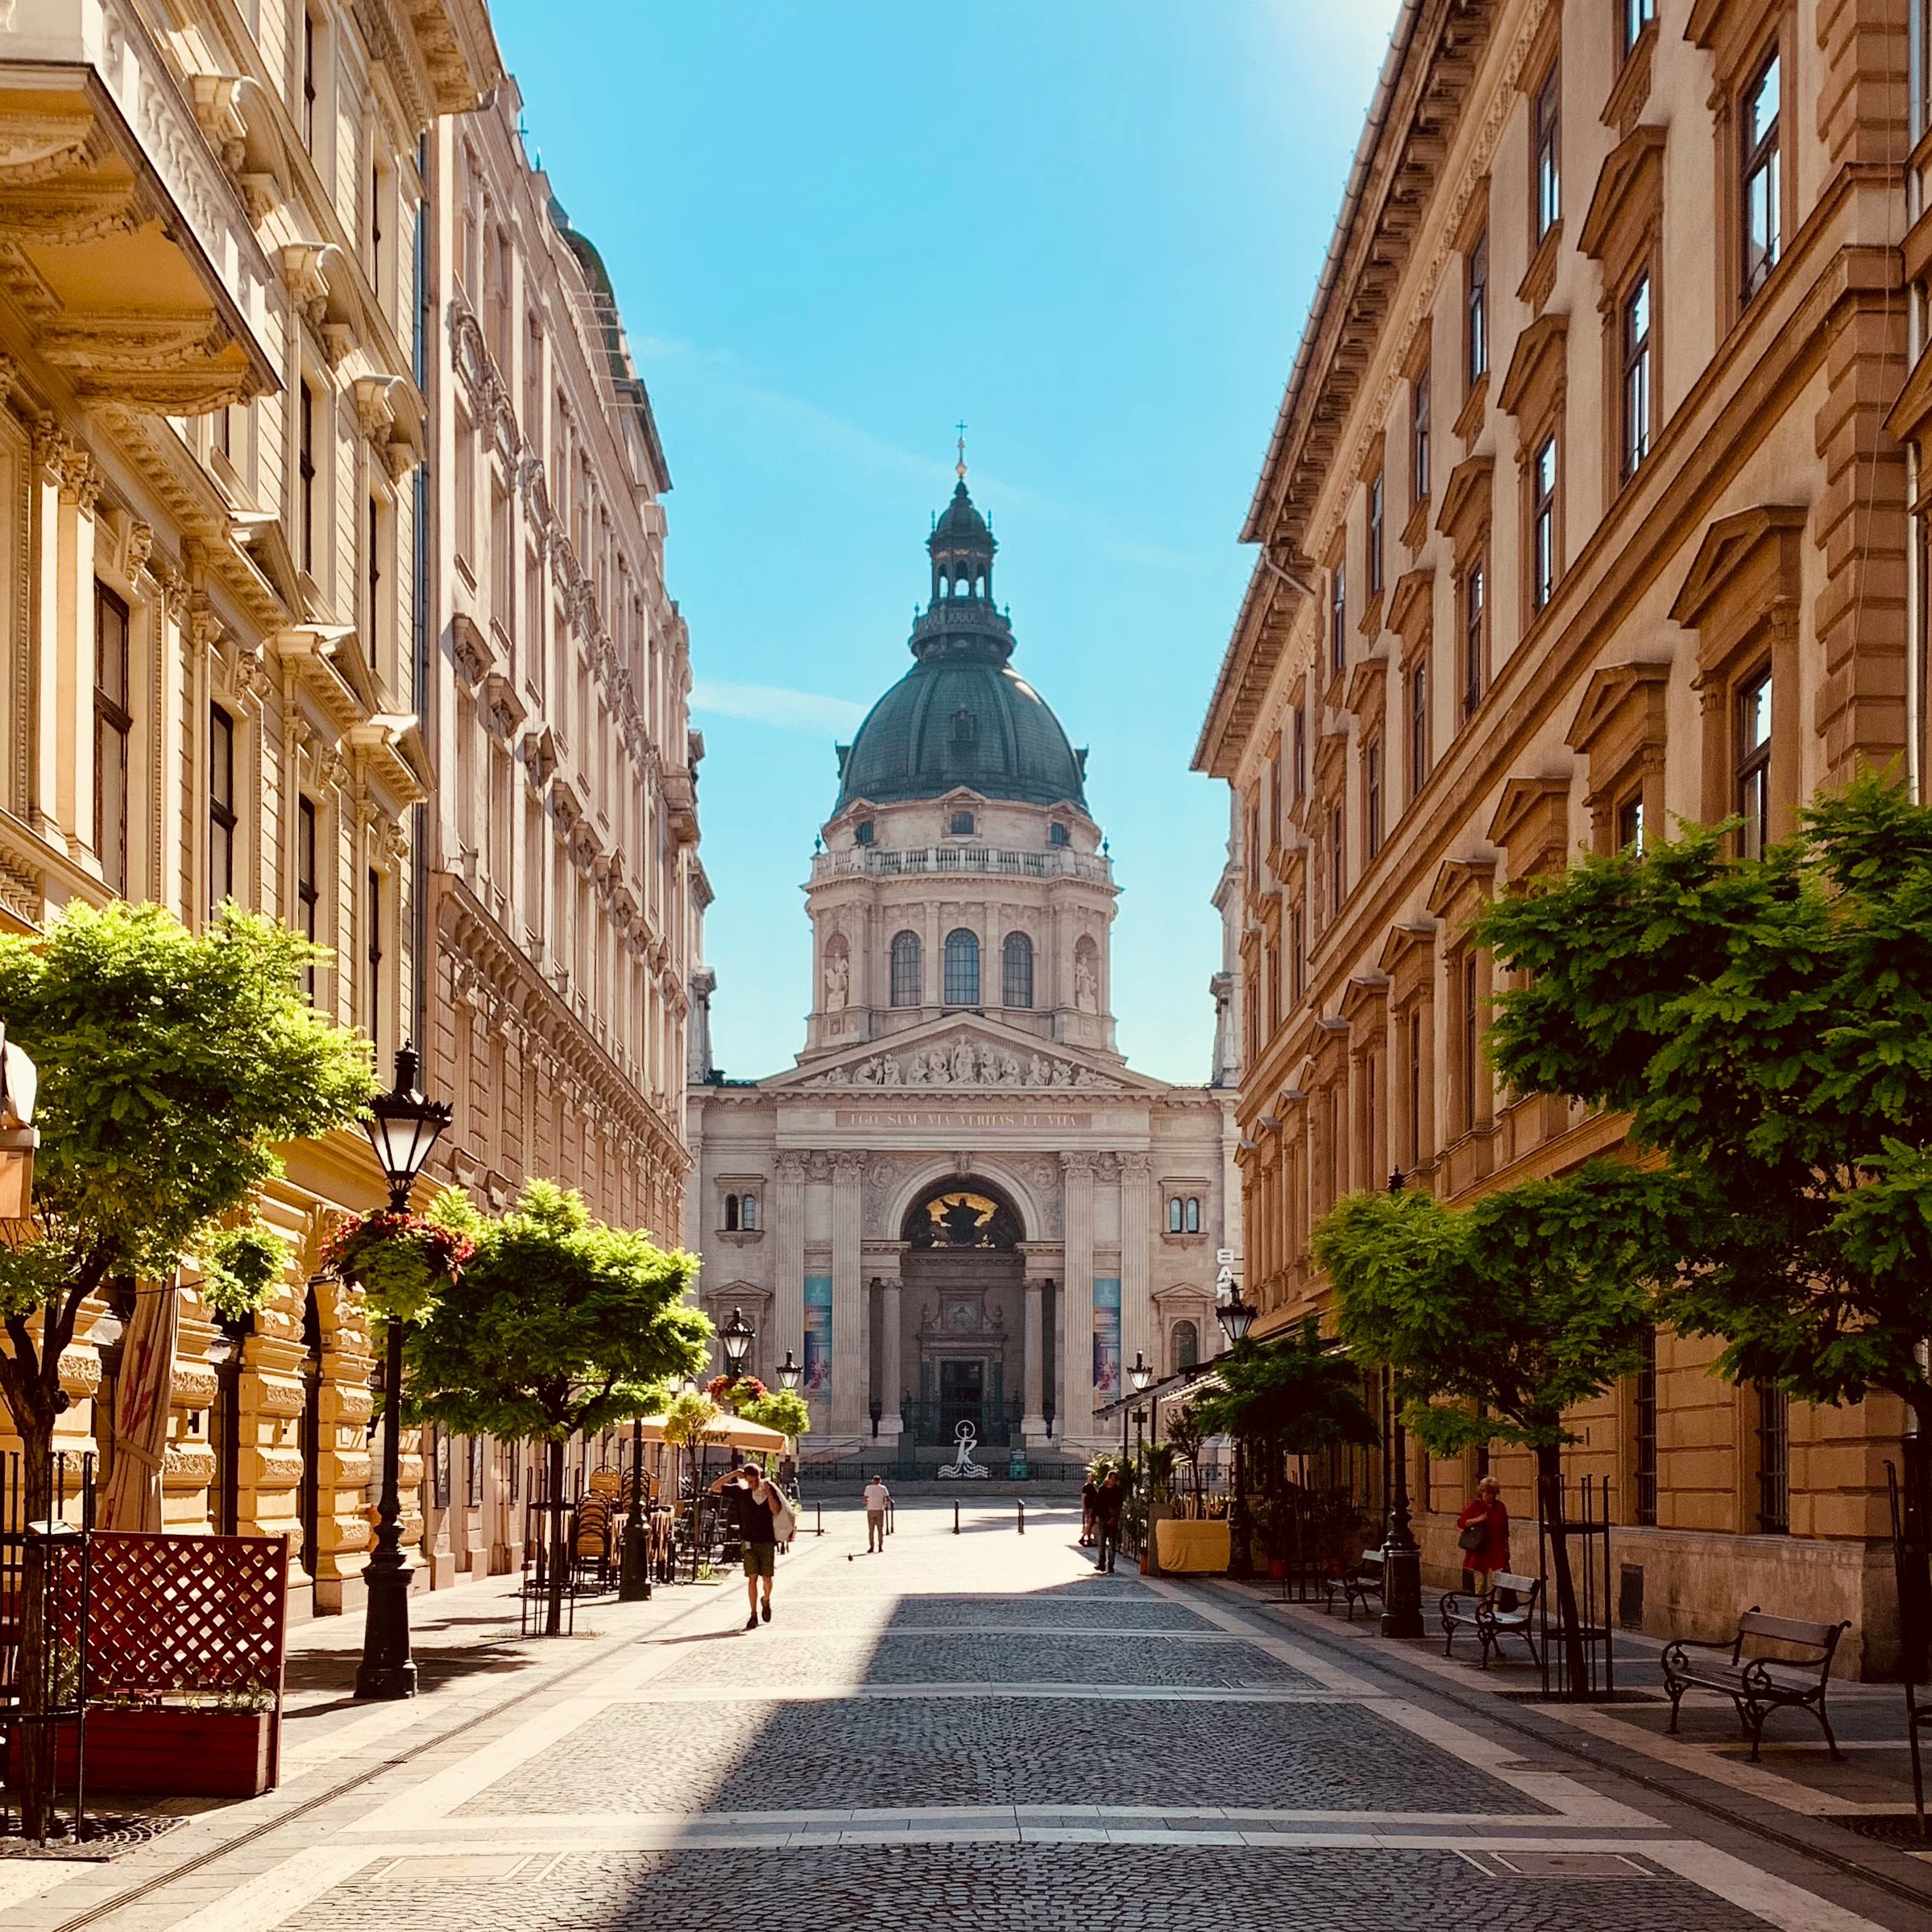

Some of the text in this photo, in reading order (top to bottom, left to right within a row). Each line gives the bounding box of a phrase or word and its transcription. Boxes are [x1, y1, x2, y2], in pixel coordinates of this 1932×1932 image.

[851, 1113, 1076, 1126] EGO SUM VIA VERITAS ET VITA
